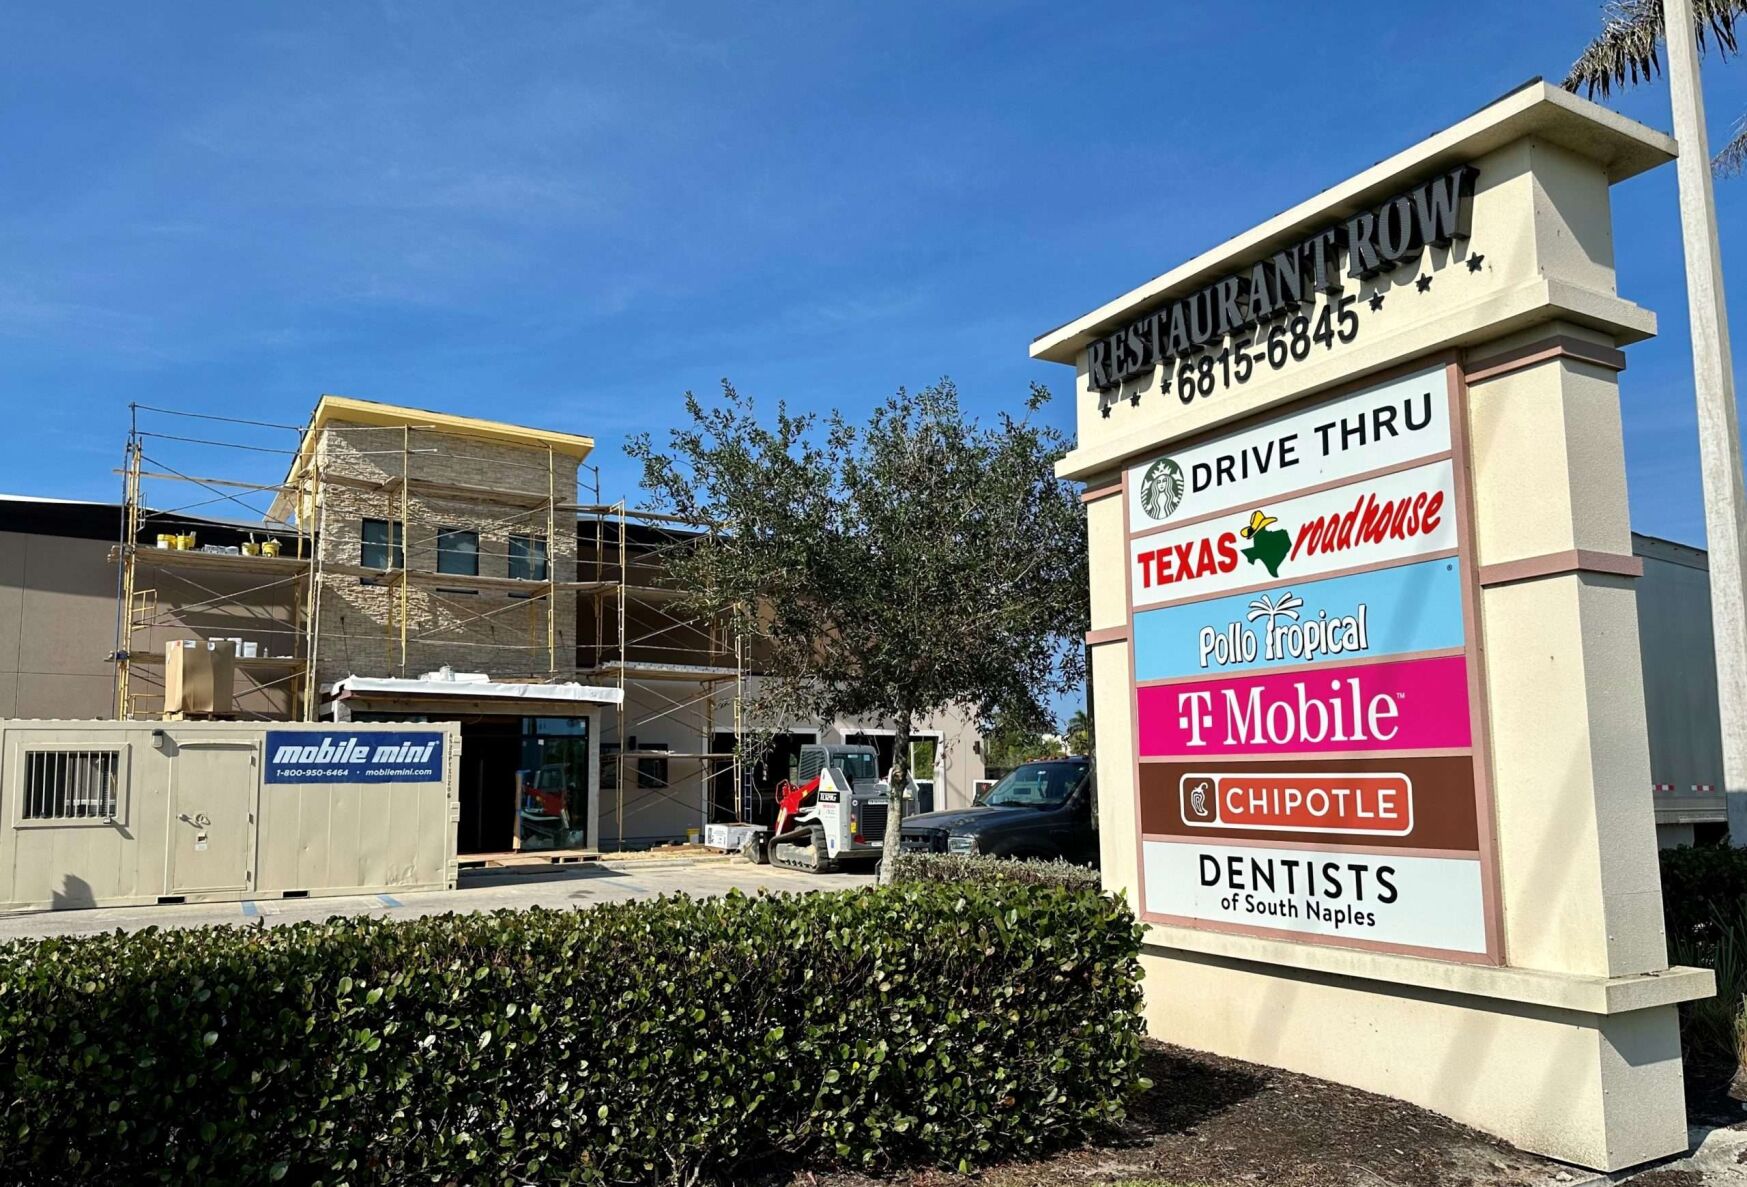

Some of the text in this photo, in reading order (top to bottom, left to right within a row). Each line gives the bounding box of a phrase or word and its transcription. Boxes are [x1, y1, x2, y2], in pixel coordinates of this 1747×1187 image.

[1087, 165, 1480, 393] RESTAURANT ROW
[1177, 295, 1359, 404] 6815-6845
[1191, 392, 1433, 494] DRIVE THRU
[1137, 532, 1238, 589] TEXAS
[1199, 591, 1369, 668] Pollo Tropical
[1221, 677, 1399, 746] Mobile
[272, 737, 436, 764] mobile mini
[276, 768, 433, 777] 1-800-950-6464 mobilemini.com
[1225, 787, 1398, 820] CHIPOTLE
[1199, 853, 1399, 904] DENTISTS
[1221, 892, 1376, 929] of South Naples
